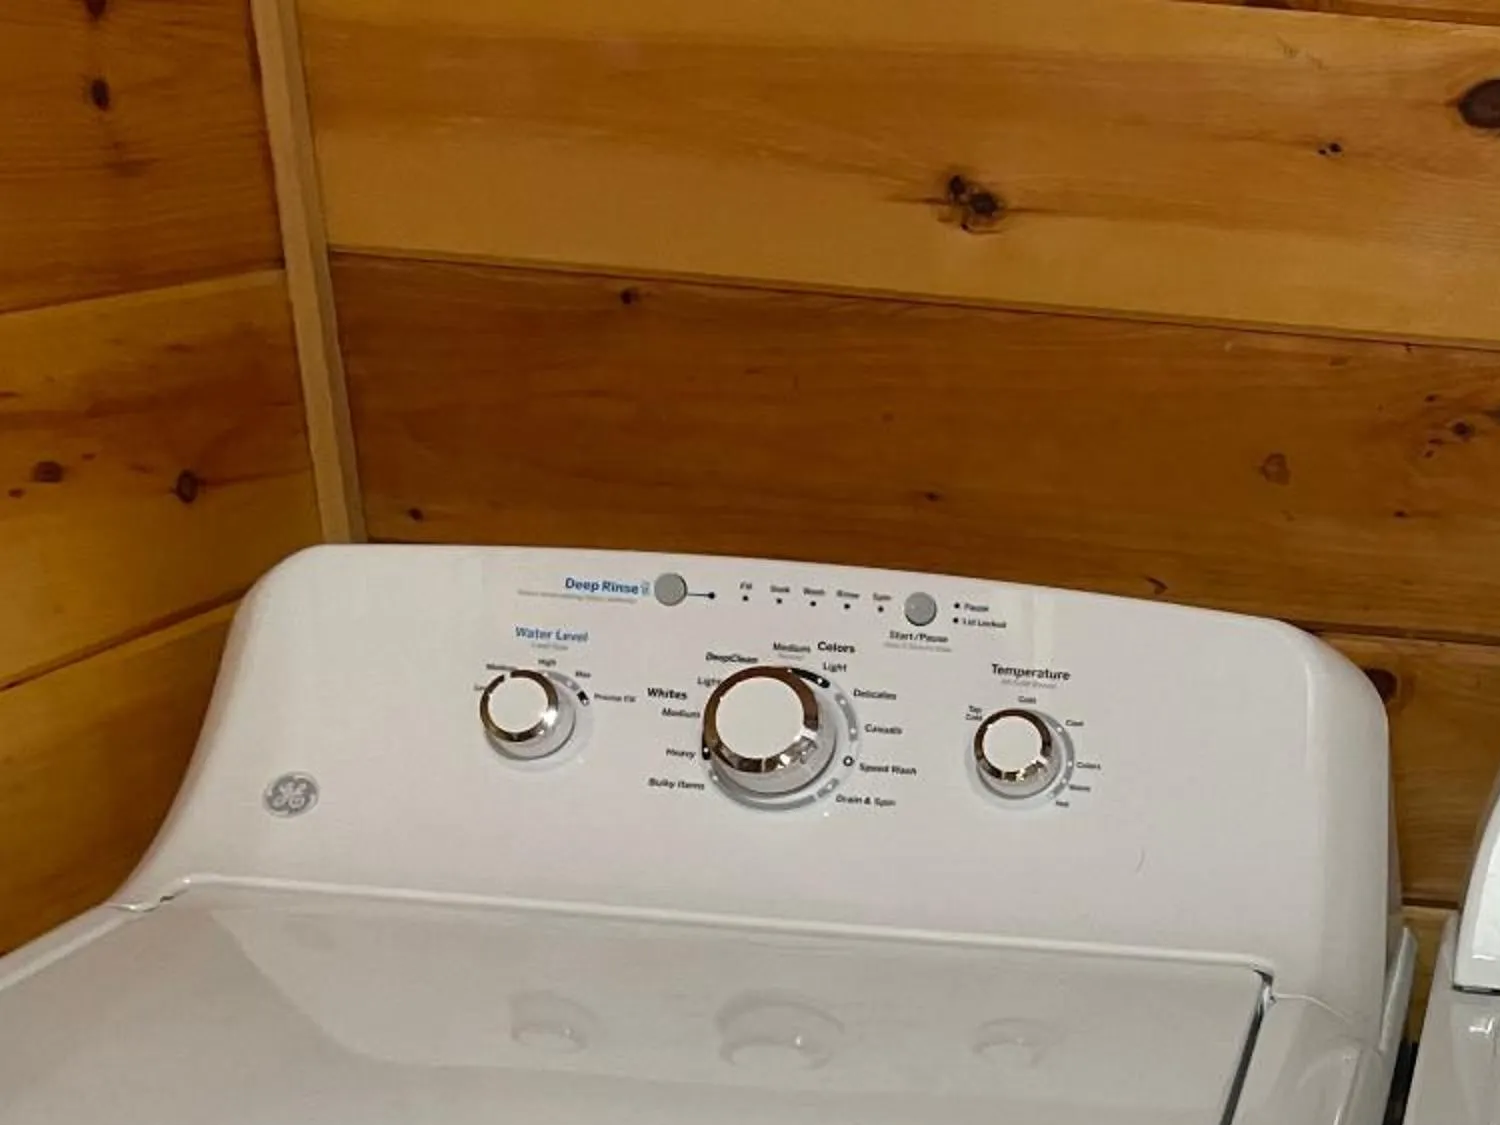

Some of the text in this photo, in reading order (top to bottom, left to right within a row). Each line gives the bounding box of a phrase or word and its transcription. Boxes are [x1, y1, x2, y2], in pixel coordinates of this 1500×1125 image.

[564, 577, 639, 595] Deep Rinse
[515, 627, 588, 642] Water Level
[889, 631, 949, 643] Start/Pause
[817, 641, 856, 653] Colors
[823, 662, 847, 673] Light
[992, 663, 1071, 681] Temperature
[647, 687, 688, 700] Whites
[853, 688, 897, 700] Delicates
[665, 748, 696, 759] Heavy
[648, 777, 675, 789] Bulky
